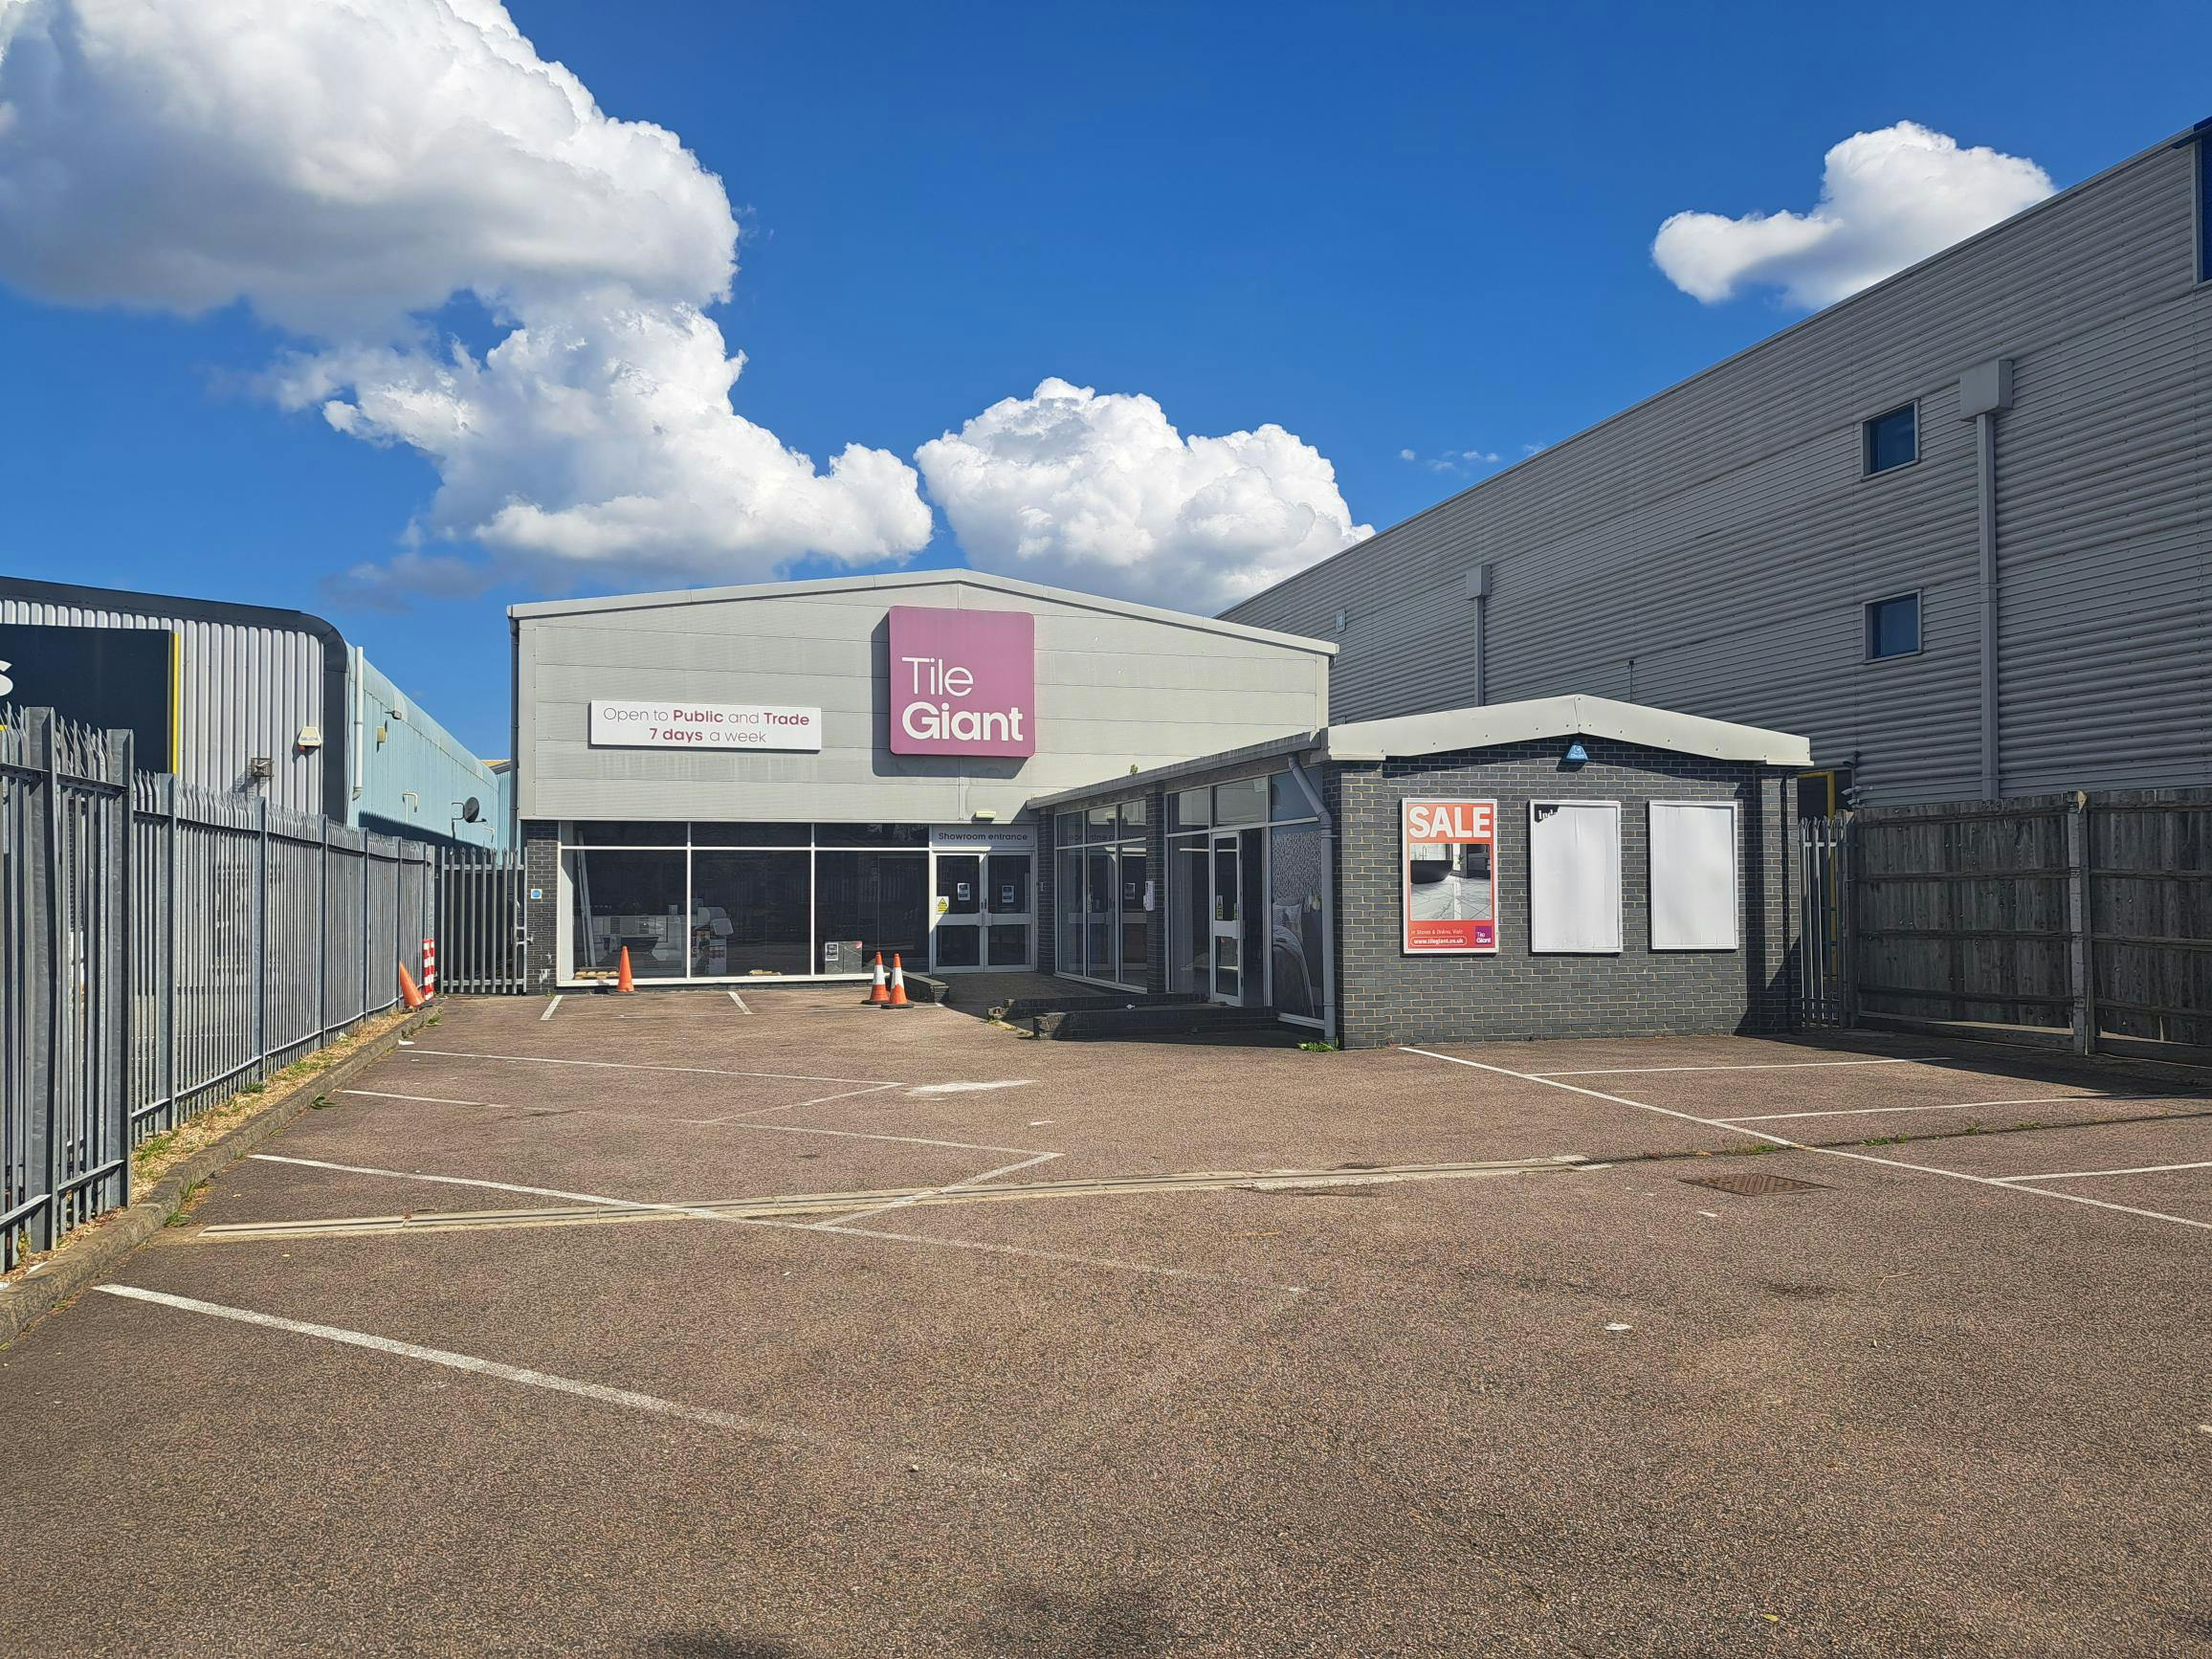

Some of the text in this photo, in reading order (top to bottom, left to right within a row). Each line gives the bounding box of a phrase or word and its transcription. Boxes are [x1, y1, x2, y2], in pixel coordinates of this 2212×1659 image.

[902, 657, 974, 697] Tile
[603, 707, 809, 725] Open to Public and Trade
[902, 701, 1024, 741] Giant
[649, 728, 766, 743] 7 days a week
[1409, 807, 1492, 838] SALE
[987, 832, 1028, 841] entrance
